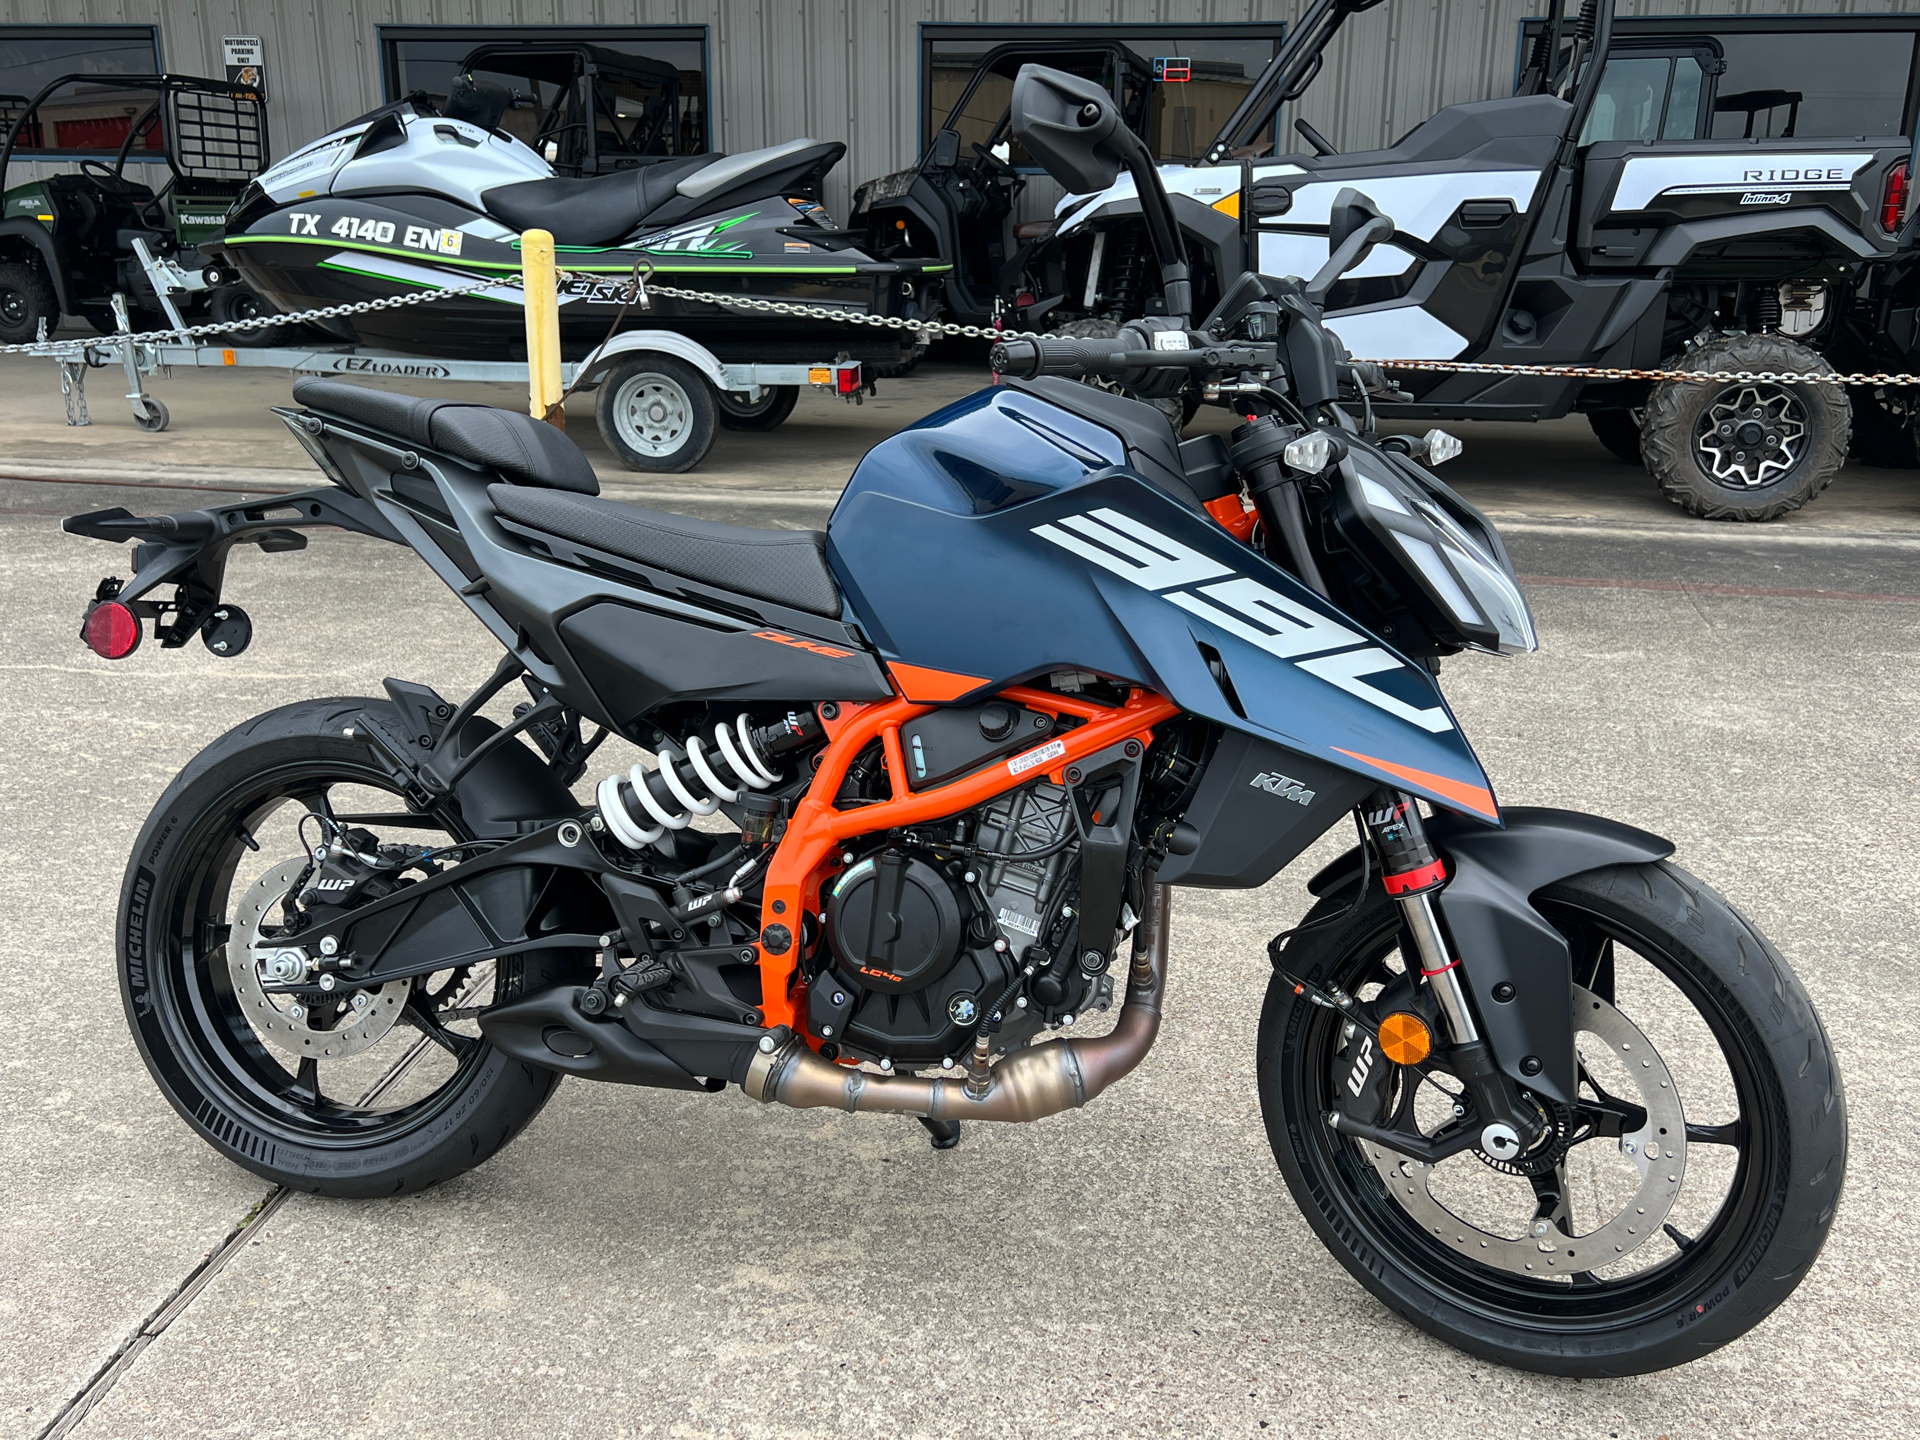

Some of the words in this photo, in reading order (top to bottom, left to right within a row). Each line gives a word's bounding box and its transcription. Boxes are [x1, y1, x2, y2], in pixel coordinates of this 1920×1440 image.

[1743, 168, 1843, 181] RIDGE
[180, 214, 225, 225] Kawasa
[289, 213, 321, 235] TX
[331, 216, 396, 243] 4140
[403, 225, 440, 250] EN
[446, 235, 455, 247] 6
[750, 631, 856, 658] DUKE
[786, 711, 804, 736] WP
[1249, 771, 1316, 806] KTM
[1368, 801, 1410, 826] WP
[1381, 821, 1405, 834] APEX
[148, 826, 172, 866] POWER
[171, 815, 179, 825] 6
[317, 879, 356, 891] WP
[687, 894, 713, 911] WP
[1620, 890, 1687, 932] POWER
[128, 877, 151, 988] MICHELIN
[1347, 1035, 1373, 1097] WP
[468, 1067, 494, 1104] 150/60
[455, 1104, 467, 1119] ZR
[444, 1118, 454, 1131] 17
[1291, 1134, 1307, 1164] FRONT
[277, 1159, 299, 1169] RADIAL
[1737, 1208, 1780, 1281] MICHELIN
[1676, 1318, 1685, 1329] 6
